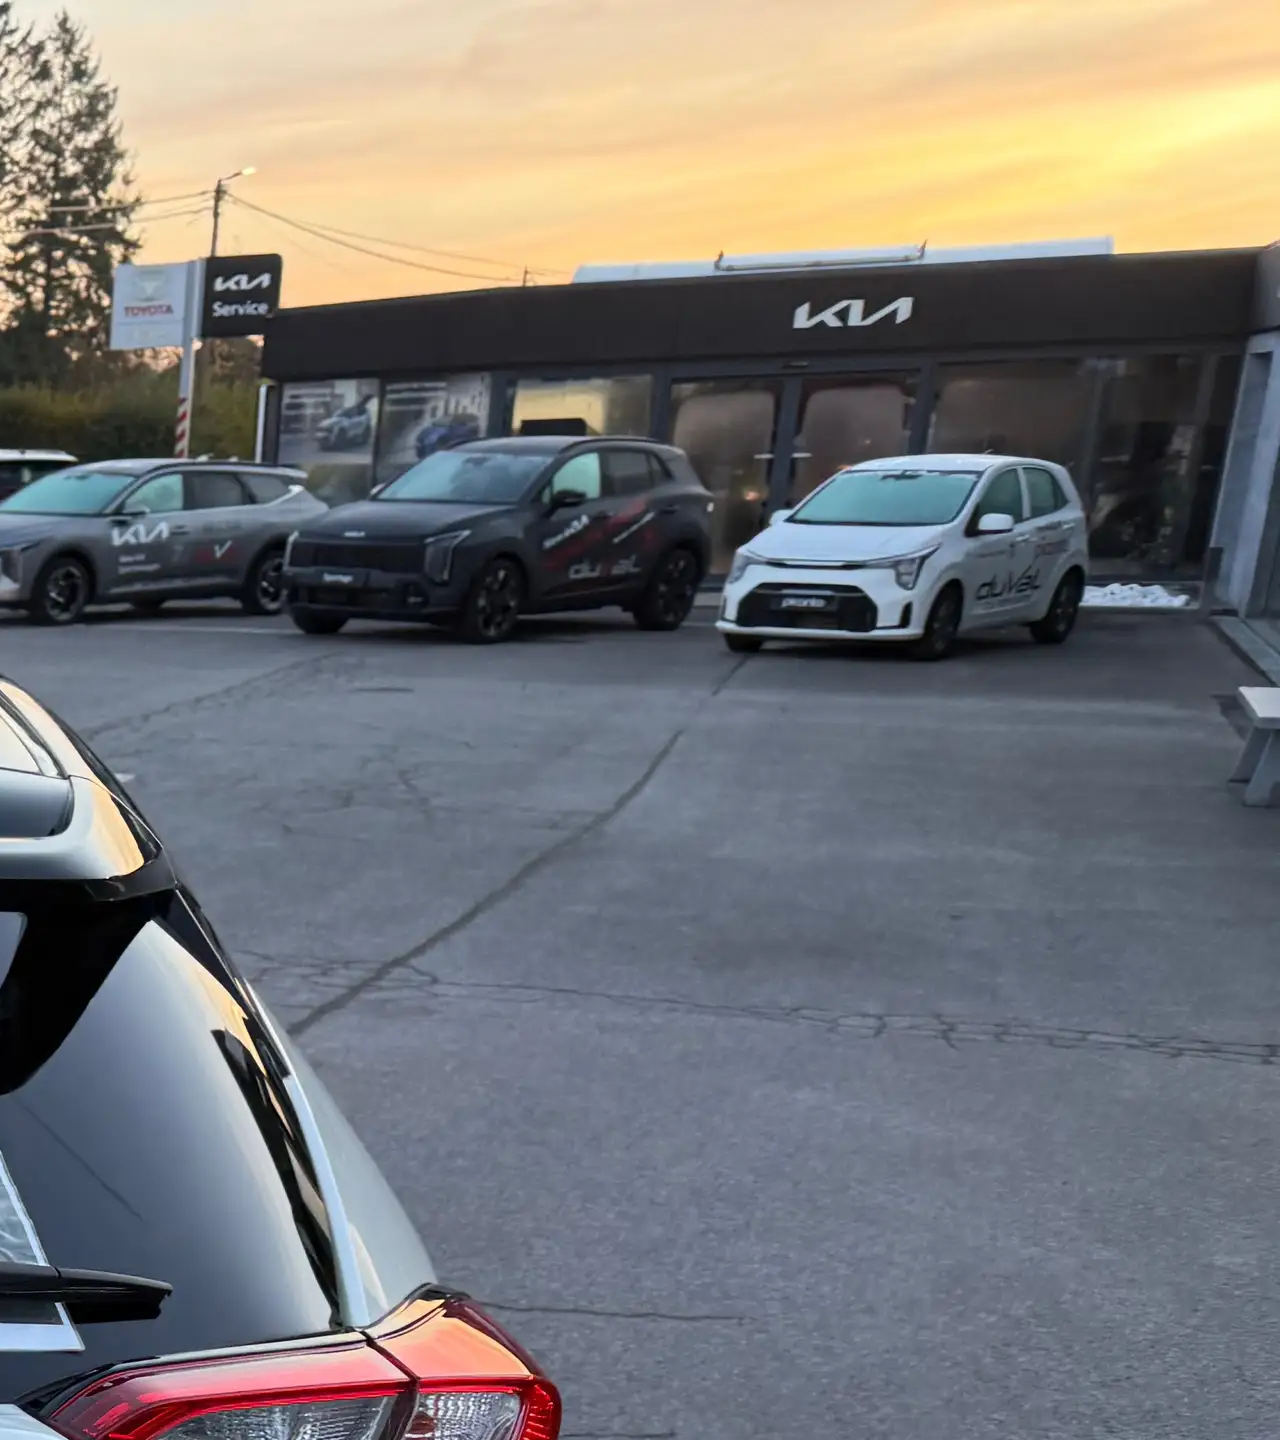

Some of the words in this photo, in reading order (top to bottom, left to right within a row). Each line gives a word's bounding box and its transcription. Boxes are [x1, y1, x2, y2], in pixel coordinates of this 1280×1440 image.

[213, 272, 272, 292] KIA
[124, 304, 173, 317] TOYOTA
[212, 301, 269, 317] Service
[793, 297, 914, 329] KIA
[111, 521, 170, 546] KIA
